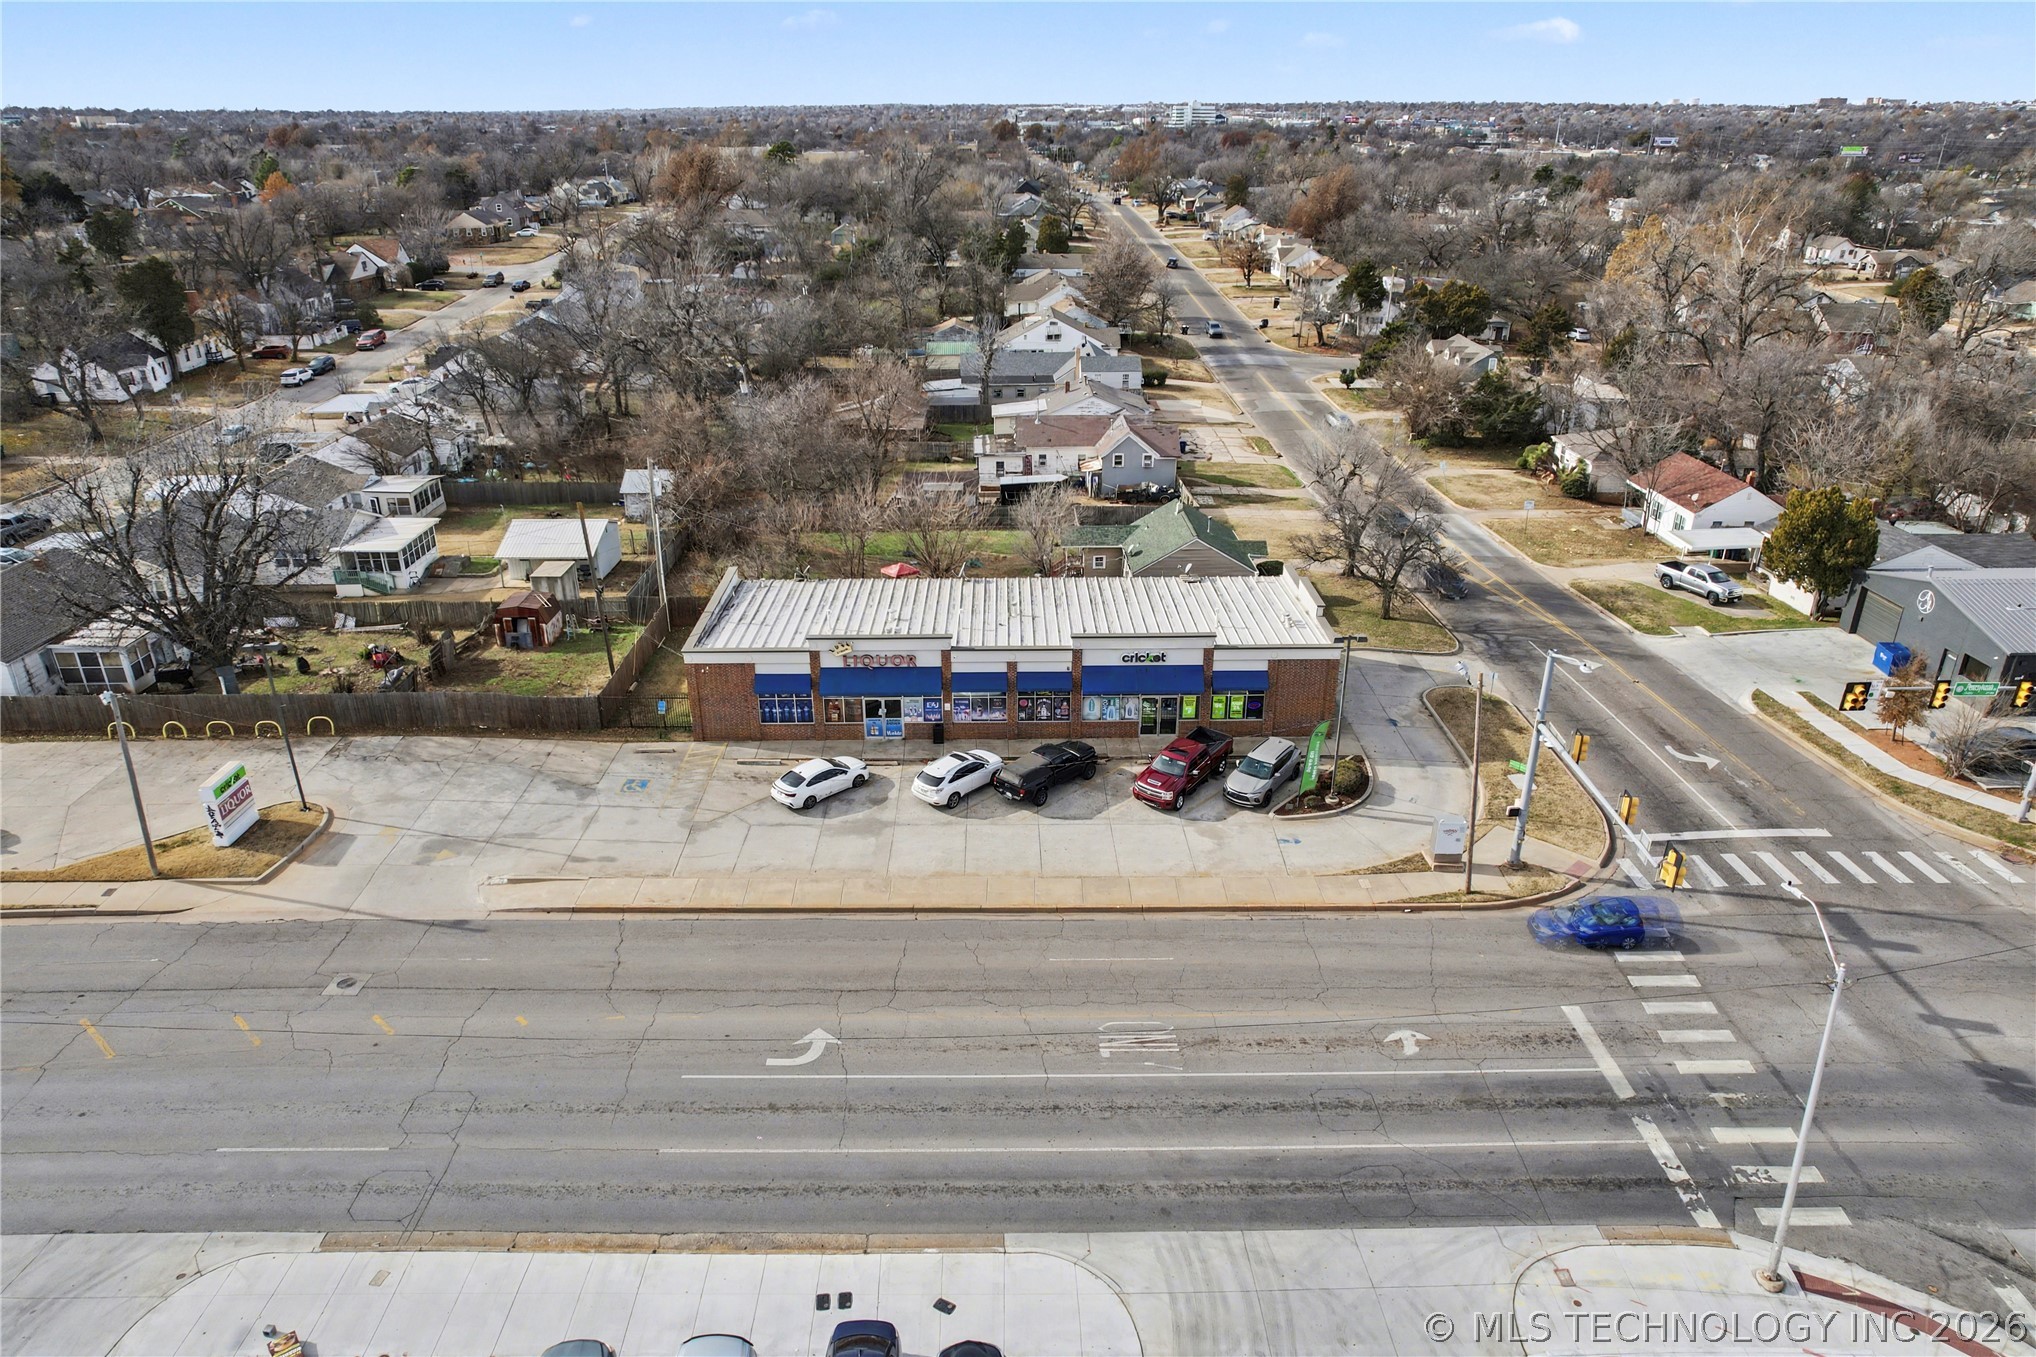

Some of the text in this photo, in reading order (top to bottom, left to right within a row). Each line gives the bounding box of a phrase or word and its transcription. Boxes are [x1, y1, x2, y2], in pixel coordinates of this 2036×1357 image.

[843, 654, 917, 669] LIQUOR
[1121, 652, 1166, 663] cricket
[220, 784, 252, 815] LIQUOR
